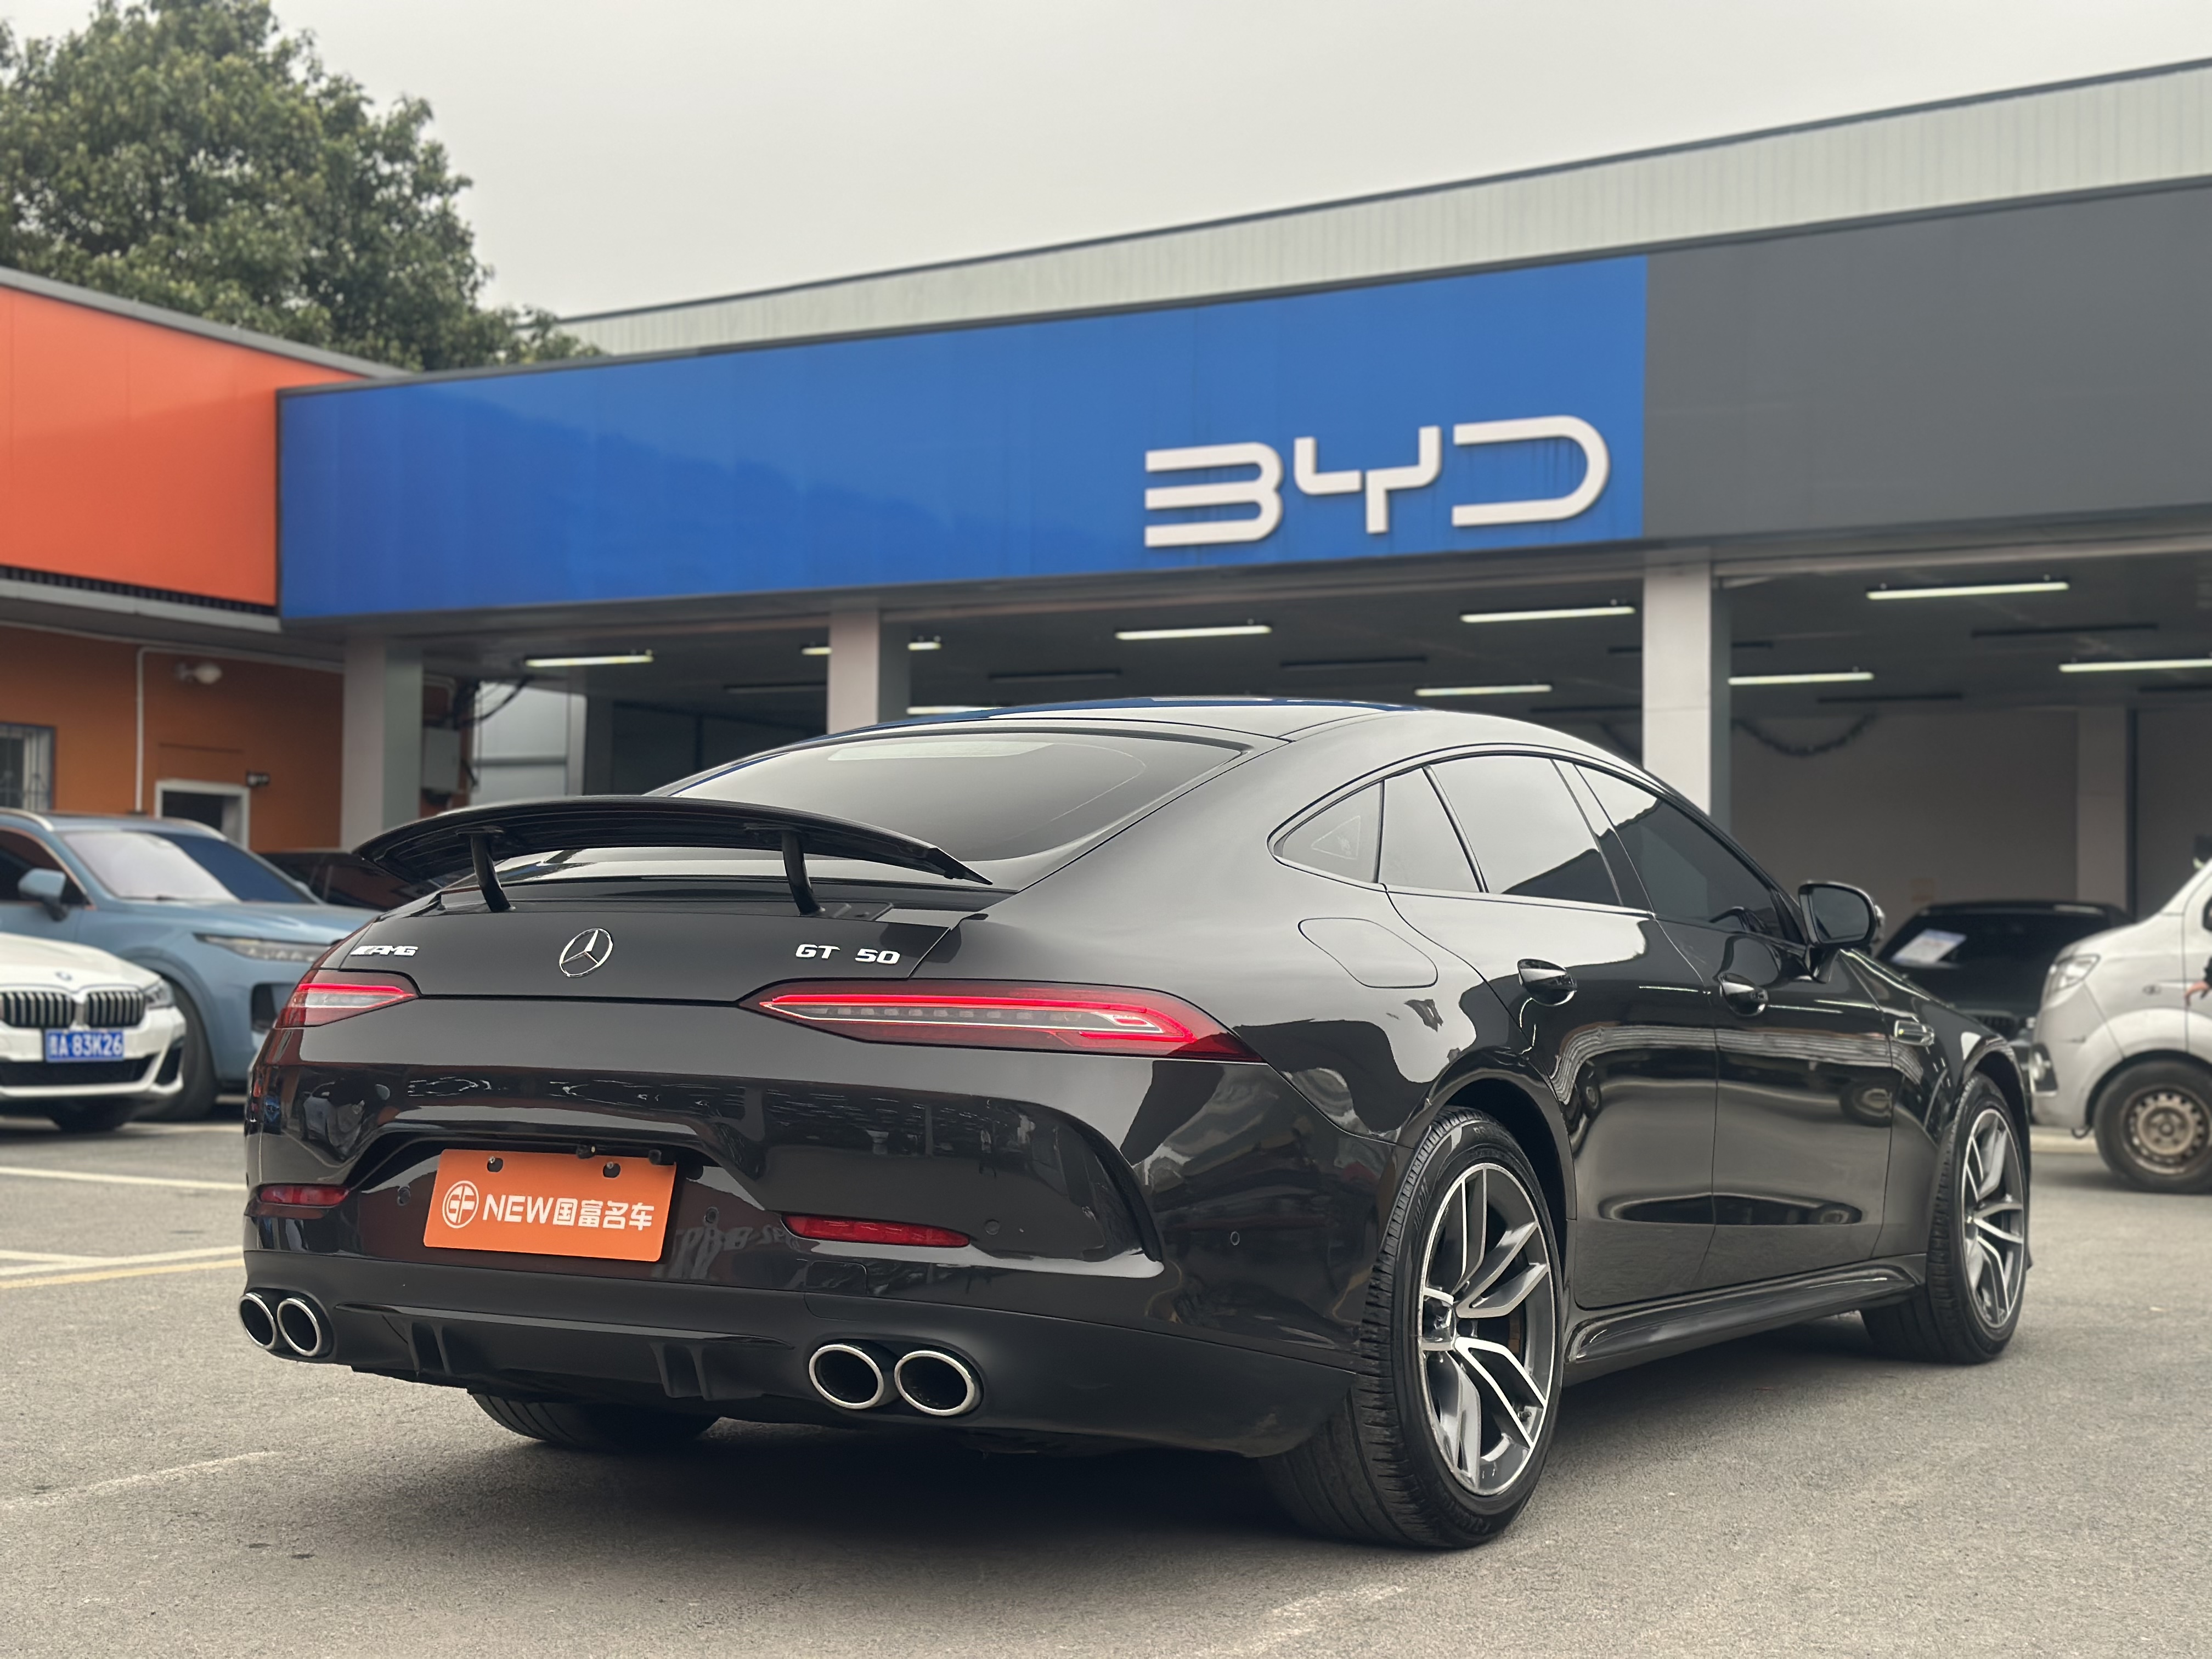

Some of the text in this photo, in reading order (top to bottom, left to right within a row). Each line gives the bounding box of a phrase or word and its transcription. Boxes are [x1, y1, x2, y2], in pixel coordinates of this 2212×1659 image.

[1145, 415, 1610, 547] BYD
[795, 944, 900, 964] GT 50
